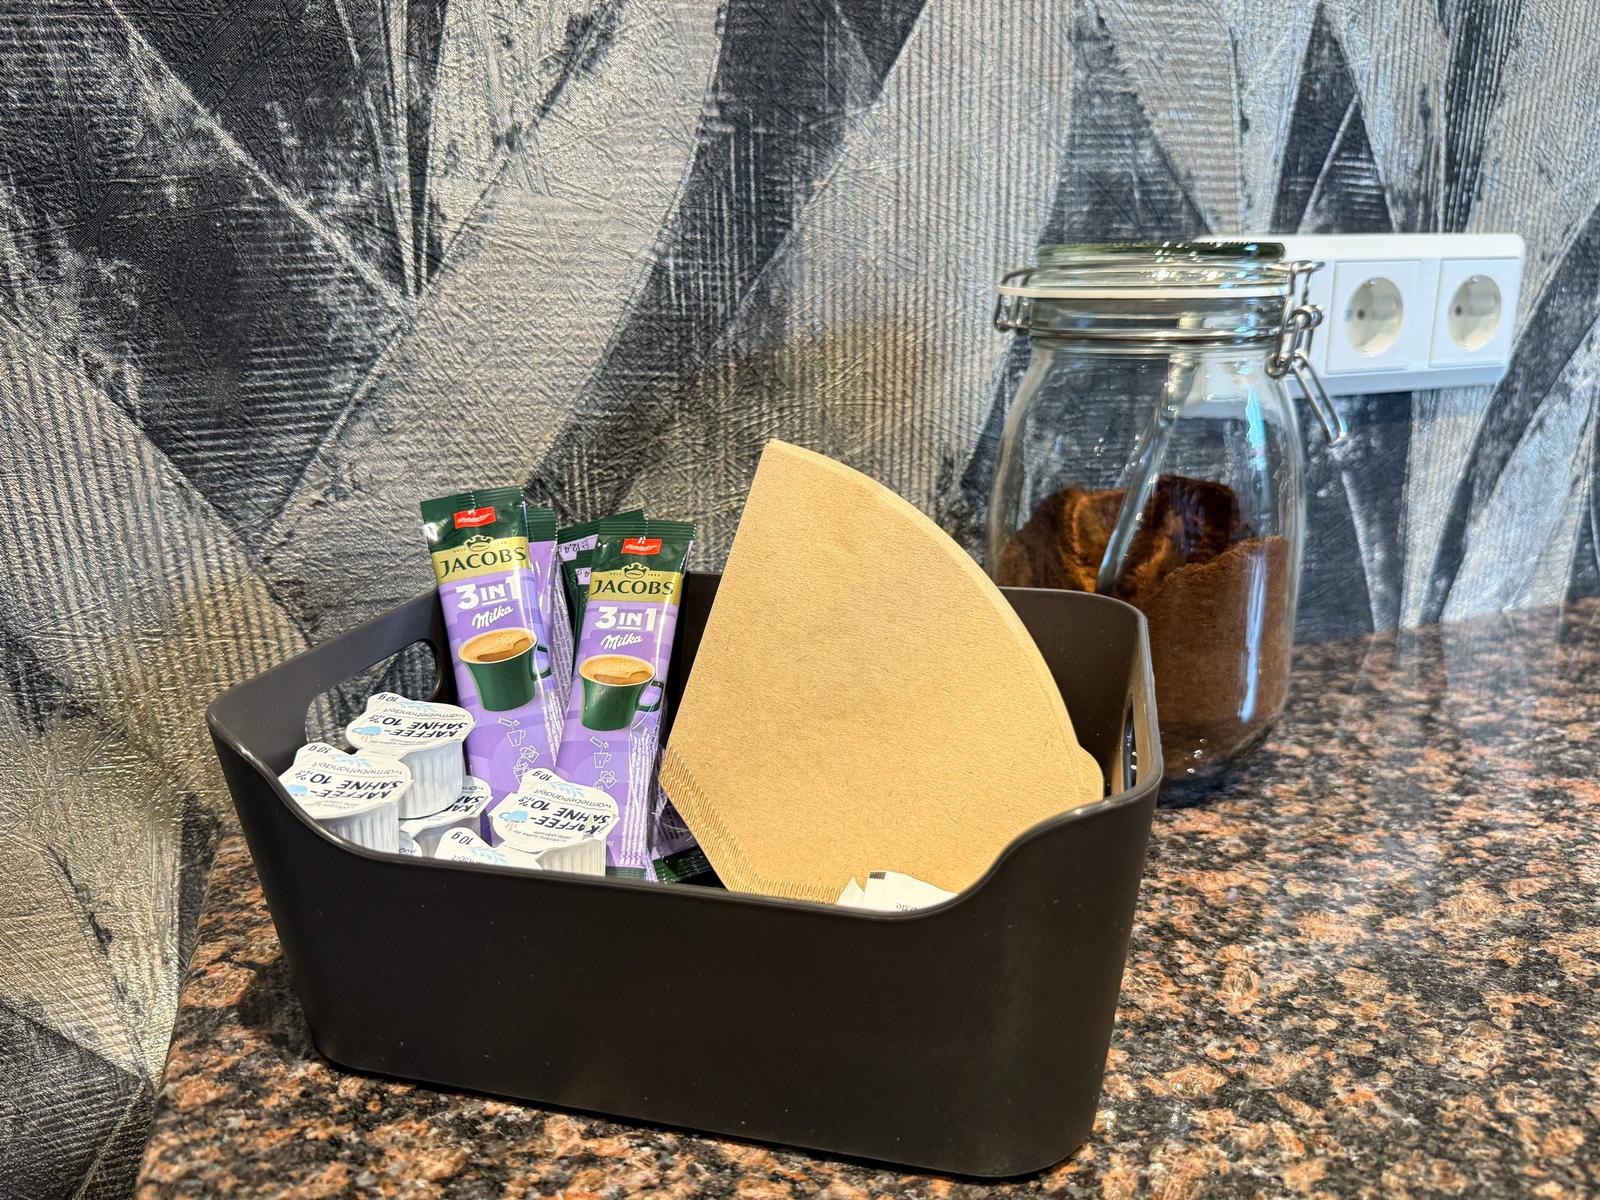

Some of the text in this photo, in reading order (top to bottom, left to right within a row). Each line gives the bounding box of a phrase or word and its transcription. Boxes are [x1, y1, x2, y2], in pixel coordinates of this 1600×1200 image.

[440, 546, 528, 579] JACOBS
[590, 579, 675, 596] JACOBS
[472, 605, 514, 630] Milka
[601, 633, 643, 650] Milka
[406, 721, 468, 731] SAHNE
[336, 780, 404, 790] SAHNE
[552, 807, 611, 824] SAHNE
